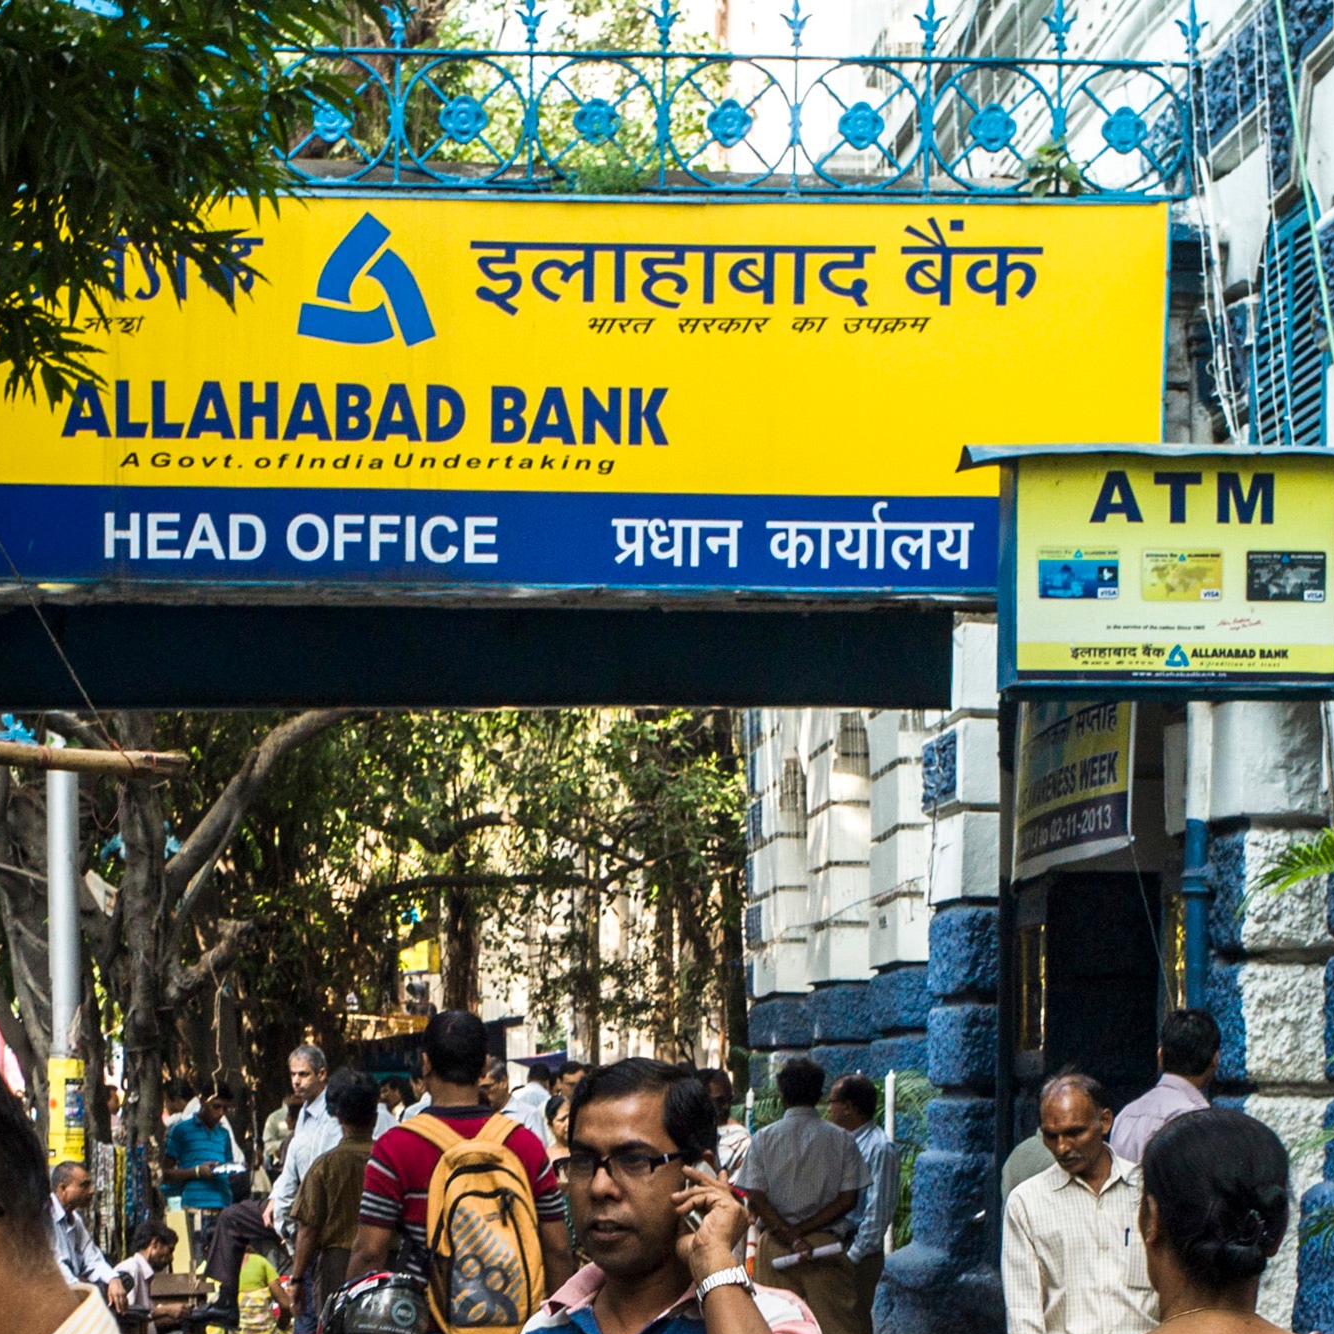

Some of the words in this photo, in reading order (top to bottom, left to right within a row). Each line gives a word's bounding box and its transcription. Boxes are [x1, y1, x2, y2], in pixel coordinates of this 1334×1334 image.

[470, 241, 876, 316] इलाहाबाद
[901, 217, 1044, 306] बैंक
[587, 317, 655, 334] भारत
[677, 317, 770, 334] सरकार
[791, 317, 828, 334] का
[843, 317, 931, 334] उपक्रम
[61, 380, 466, 444] ALLAHABAD
[490, 386, 670, 446] BANK
[120, 452, 140, 468] A
[255, 453, 289, 469] of
[295, 453, 384, 470] India
[393, 453, 616, 475] Undertaking
[1089, 470, 1276, 525] ATM
[104, 512, 267, 560] HEAD
[286, 513, 499, 564] OFFICE
[611, 518, 743, 568] प्रधान
[765, 501, 975, 570] कार्यालय
[1070, 646, 1138, 660] इलाहाबाद
[1142, 643, 1165, 658] बैंक
[1191, 648, 1256, 659] ALLAHABAD
[1259, 649, 1289, 659] BANK
[1079, 750, 1119, 791] WEEK
[1050, 804, 1113, 844] 02-11-2013
